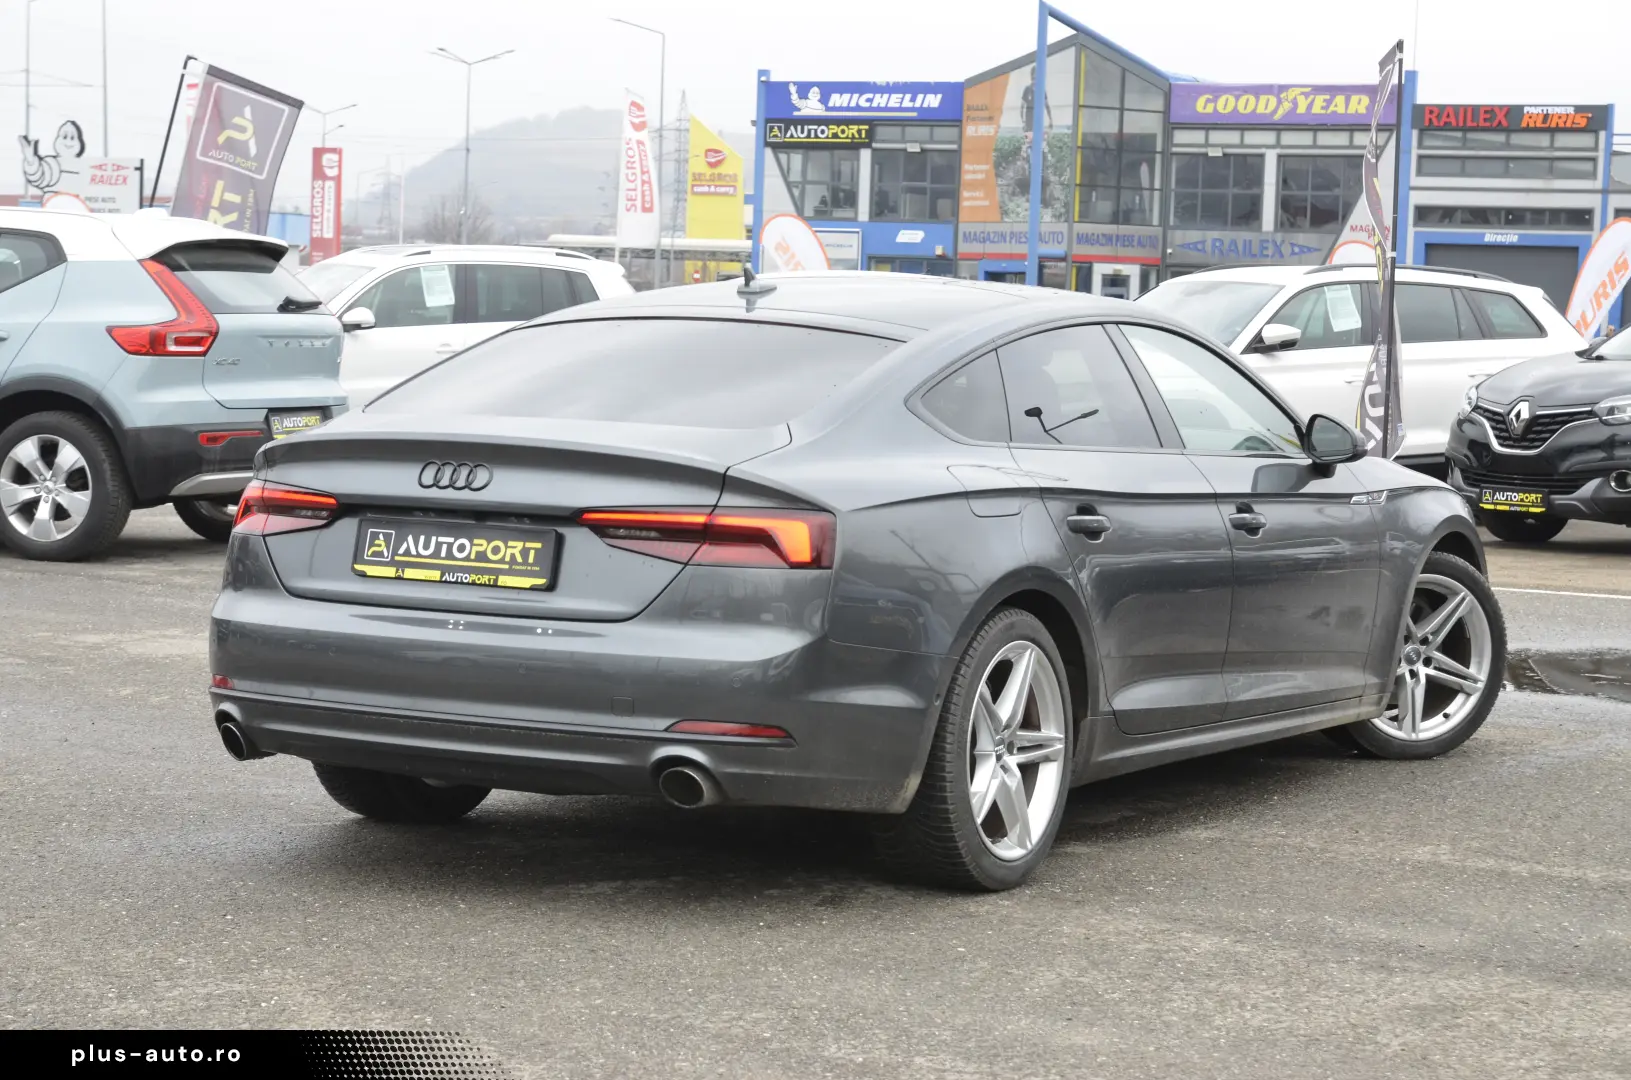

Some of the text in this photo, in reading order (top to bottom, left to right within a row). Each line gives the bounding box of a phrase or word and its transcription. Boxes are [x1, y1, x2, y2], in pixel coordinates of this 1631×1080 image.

[828, 93, 943, 108] MICHELIN
[1424, 106, 1509, 127] RAILEX
[1523, 106, 1575, 114] PARTENER
[1520, 113, 1589, 128] RURIS
[786, 125, 869, 138] AUTOPORT
[208, 149, 258, 171] AUTO PORT
[89, 174, 128, 185] RAILEX
[312, 180, 323, 238] SELGROS
[962, 231, 1064, 244] MAGAZIN PIES AUTO
[1076, 232, 1159, 249] MAGAZIN PIESE AUTO
[1211, 237, 1285, 259] RAILEX
[283, 416, 320, 428] AUTOPORT
[1494, 491, 1543, 503] AUTOPORT
[397, 534, 543, 564] AUTOPORT
[442, 572, 496, 585] AUTOPORT
